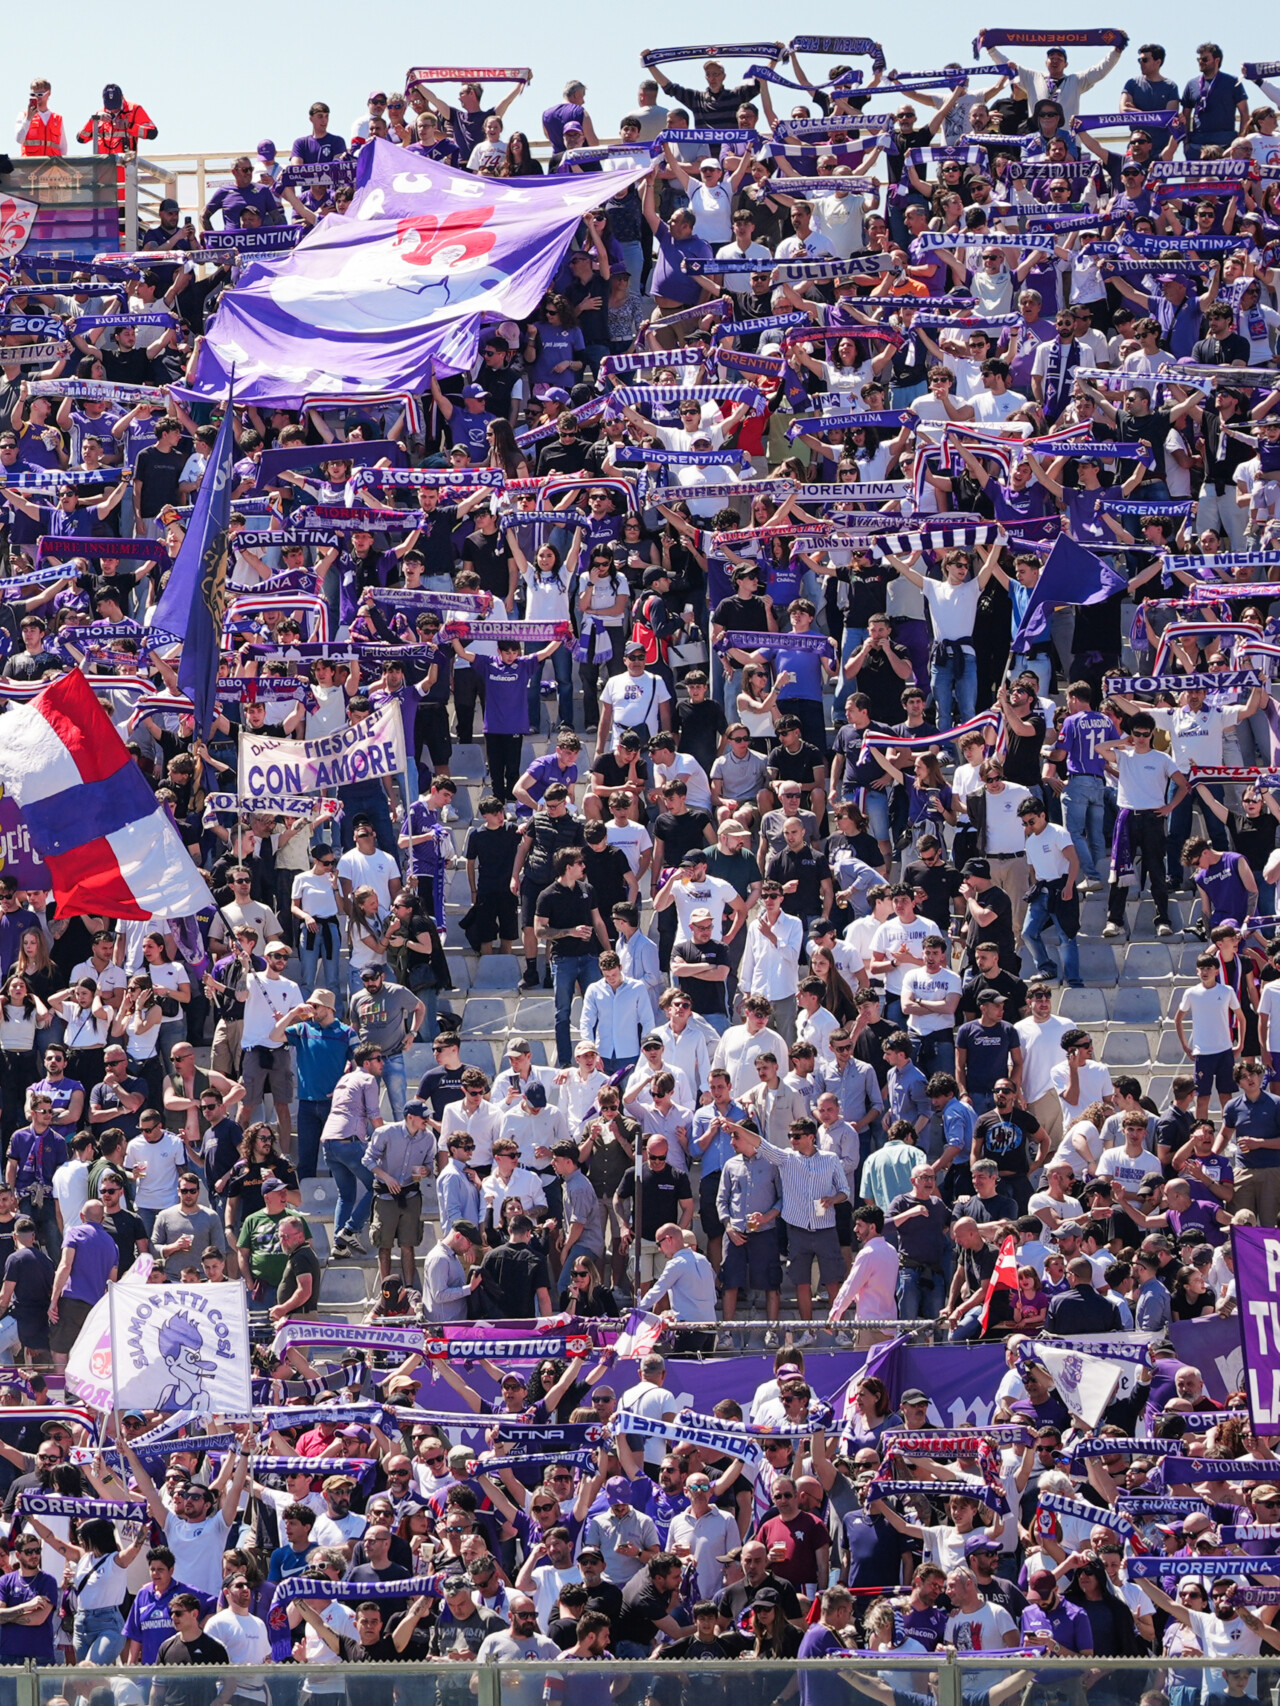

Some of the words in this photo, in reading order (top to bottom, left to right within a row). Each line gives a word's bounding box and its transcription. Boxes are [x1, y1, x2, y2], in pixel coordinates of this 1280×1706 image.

[1007, 33, 1087, 42] FIORENTINA
[911, 65, 999, 78] FIORENTINA
[790, 114, 887, 128] COLLETTIVO
[1100, 113, 1163, 124] FIORENTINA
[662, 131, 749, 141] FIORENTINA
[483, 154, 500, 167] 74
[296, 164, 335, 175] BABBO
[1154, 161, 1245, 177] COLLETTIVO
[1017, 204, 1065, 215] FIRENZE
[1053, 218, 1093, 231] DENTRO
[208, 229, 299, 247] FIORENTINA
[922, 234, 975, 249] JUVE
[981, 234, 1055, 252] MERDA
[1145, 237, 1233, 250] FIORENTINA
[786, 255, 879, 279] ULTRAS
[1118, 261, 1199, 272] FIORENTINA
[851, 297, 953, 307] FIORENTINA
[96, 314, 161, 325] FIORENTINA
[614, 347, 698, 372] ULTRAS
[819, 413, 881, 427] FIORENTINA
[1051, 442, 1117, 453] FIORENTINA
[641, 451, 734, 465] FIORENTINA
[382, 470, 453, 485] AGOSTO
[675, 482, 776, 499] FIORENTINA
[806, 539, 834, 550] LIONS
[470, 623, 555, 636] FIORENTINA
[360, 645, 436, 659] FIRENZE
[489, 672, 519, 682] Mediacom
[1108, 670, 1261, 694] FIORENZA
[1085, 732, 1107, 760] 11
[248, 762, 306, 796] CON
[313, 740, 399, 789] AMORE
[1192, 766, 1260, 780] FORZA
[124, 1303, 153, 1370] SIAMO
[149, 1289, 210, 1317] FATTI
[299, 1325, 406, 1343] laFIORENTINA
[447, 1339, 561, 1355] COLLETTIVO
[1066, 1342, 1106, 1354] PER
[1108, 1343, 1142, 1358] NOI
[680, 1415, 745, 1430] CURVA
[964, 1427, 1022, 1442] NASCE
[136, 1434, 236, 1456] FIORENTINA
[675, 1425, 756, 1460] MERDA
[1078, 1438, 1181, 1453] FIORENTINA
[286, 1456, 345, 1471] VIOLA
[878, 1481, 989, 1500] FIORENTINA
[1159, 1560, 1271, 1576] FIORENTINA
[322, 1581, 351, 1597] CHE
[356, 1582, 371, 1596] IL
[375, 1578, 438, 1595] CHIANTI
